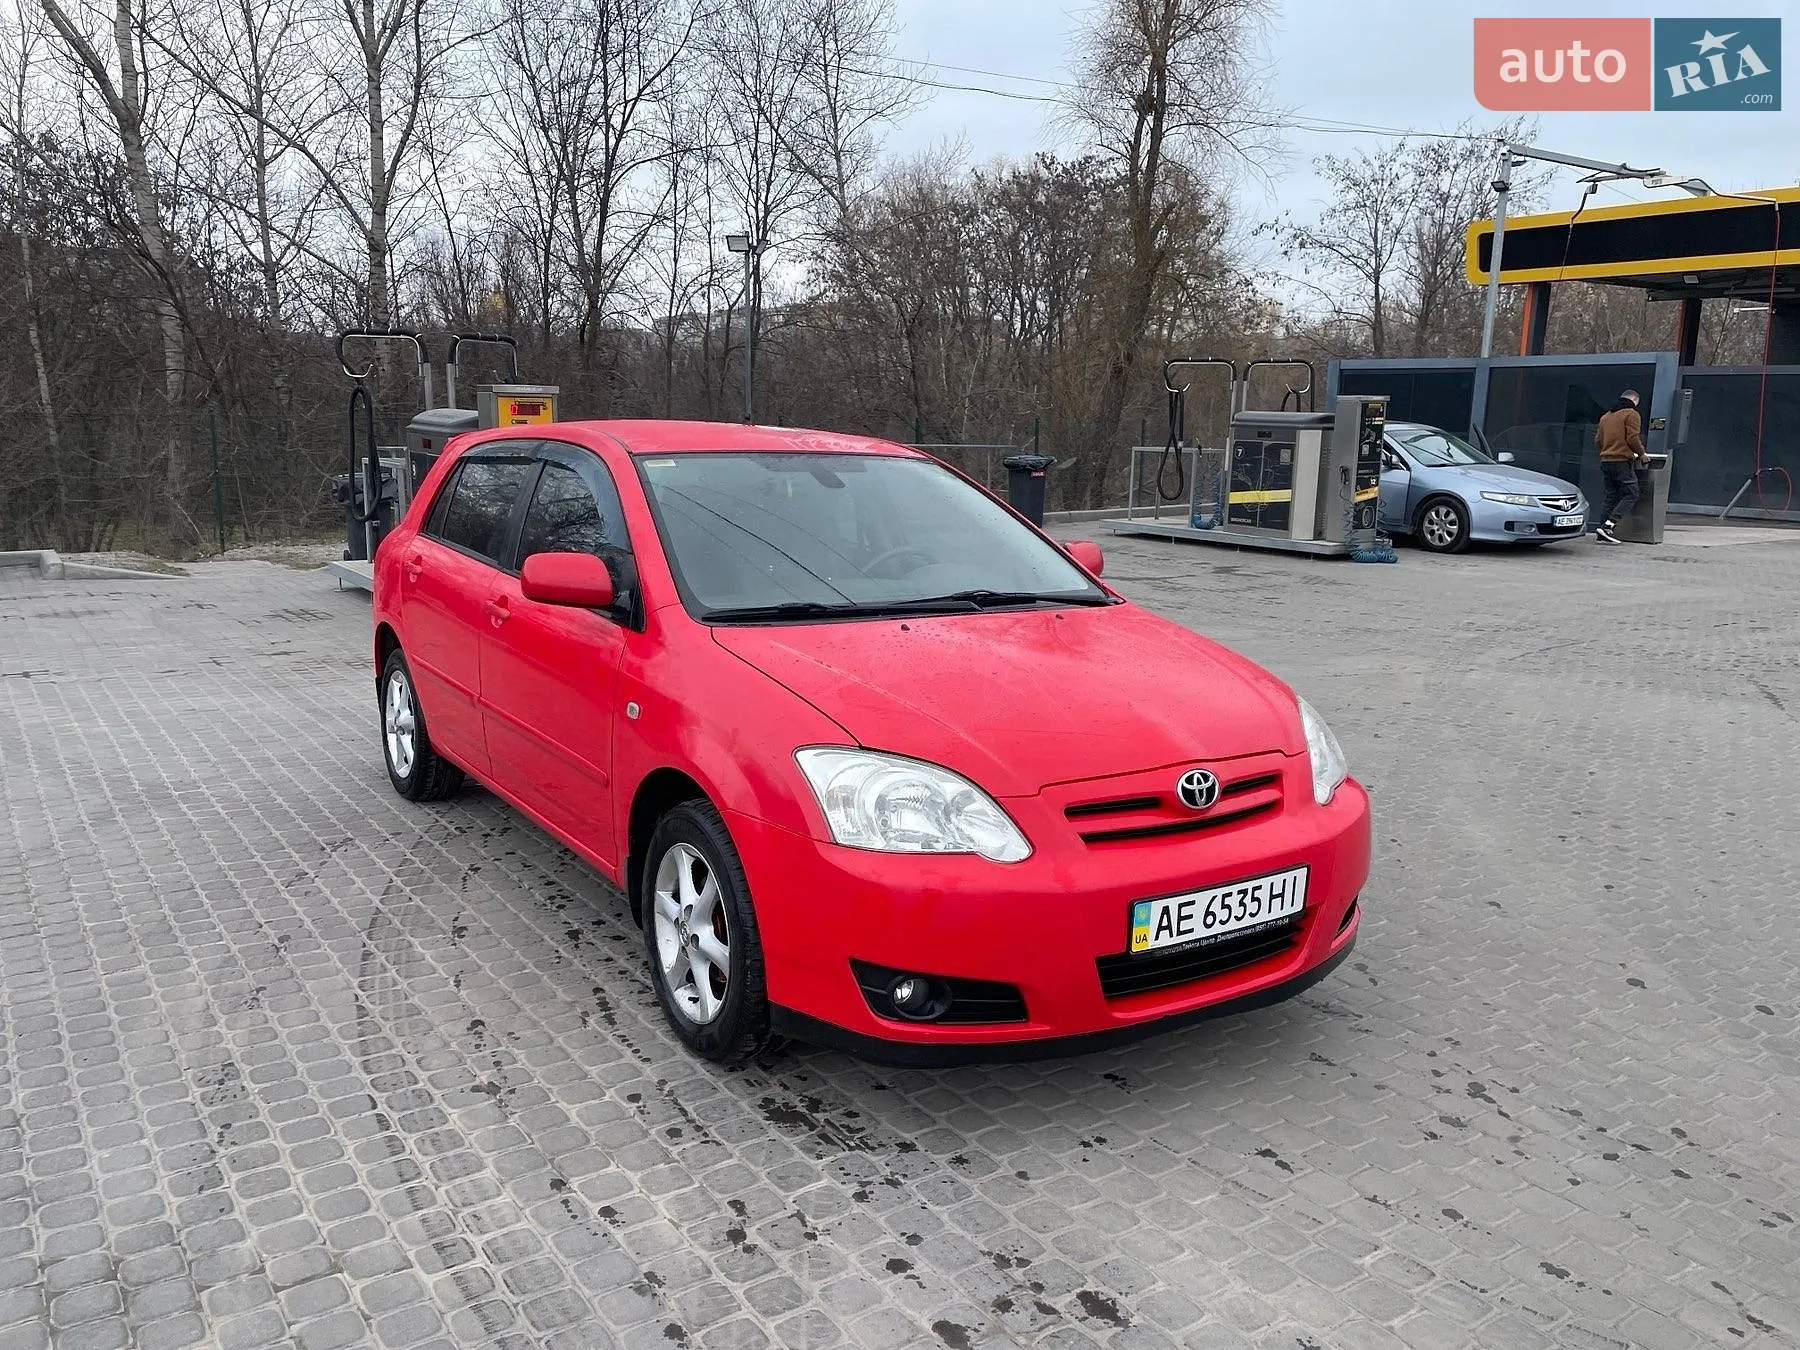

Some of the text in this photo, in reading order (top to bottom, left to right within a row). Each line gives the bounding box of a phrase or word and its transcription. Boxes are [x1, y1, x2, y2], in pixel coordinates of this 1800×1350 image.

[1154, 875, 1298, 941] AE 6535 HI
[1135, 933, 1148, 944] UA
